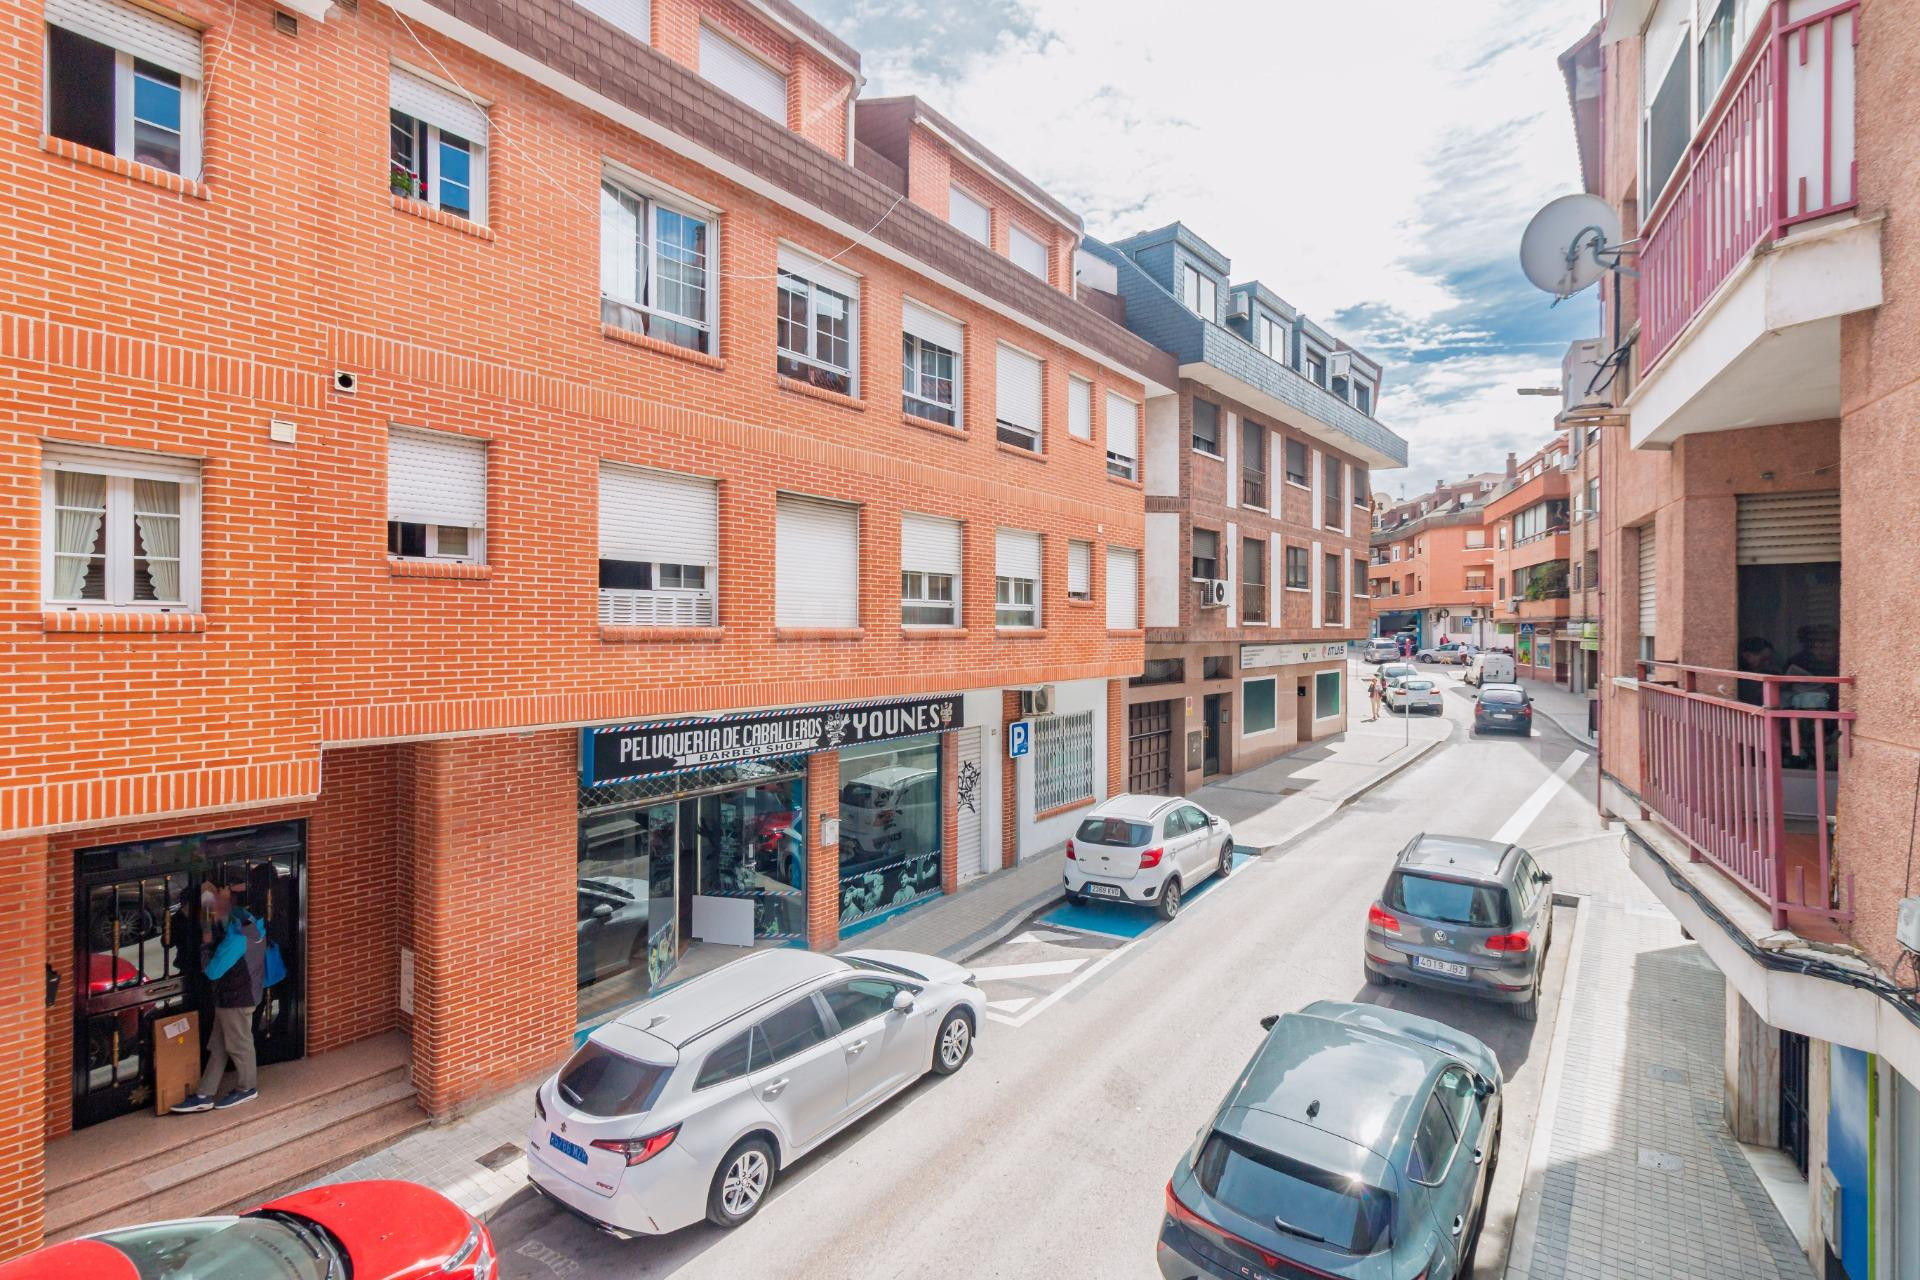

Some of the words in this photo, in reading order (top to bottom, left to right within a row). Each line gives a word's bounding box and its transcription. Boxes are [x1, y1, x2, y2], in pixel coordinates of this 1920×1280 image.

[1328, 646, 1345, 656] ATLAS
[620, 728, 721, 763] PELUQUERIA
[723, 725, 741, 747] DE
[743, 717, 823, 746] CABALLEROS
[853, 704, 940, 740] YOUNES
[1013, 726, 1025, 753] P
[699, 747, 760, 762] BARBER
[766, 740, 803, 753] SHOP
[1420, 958, 1443, 970] 4019
[1447, 965, 1464, 975] JBZ
